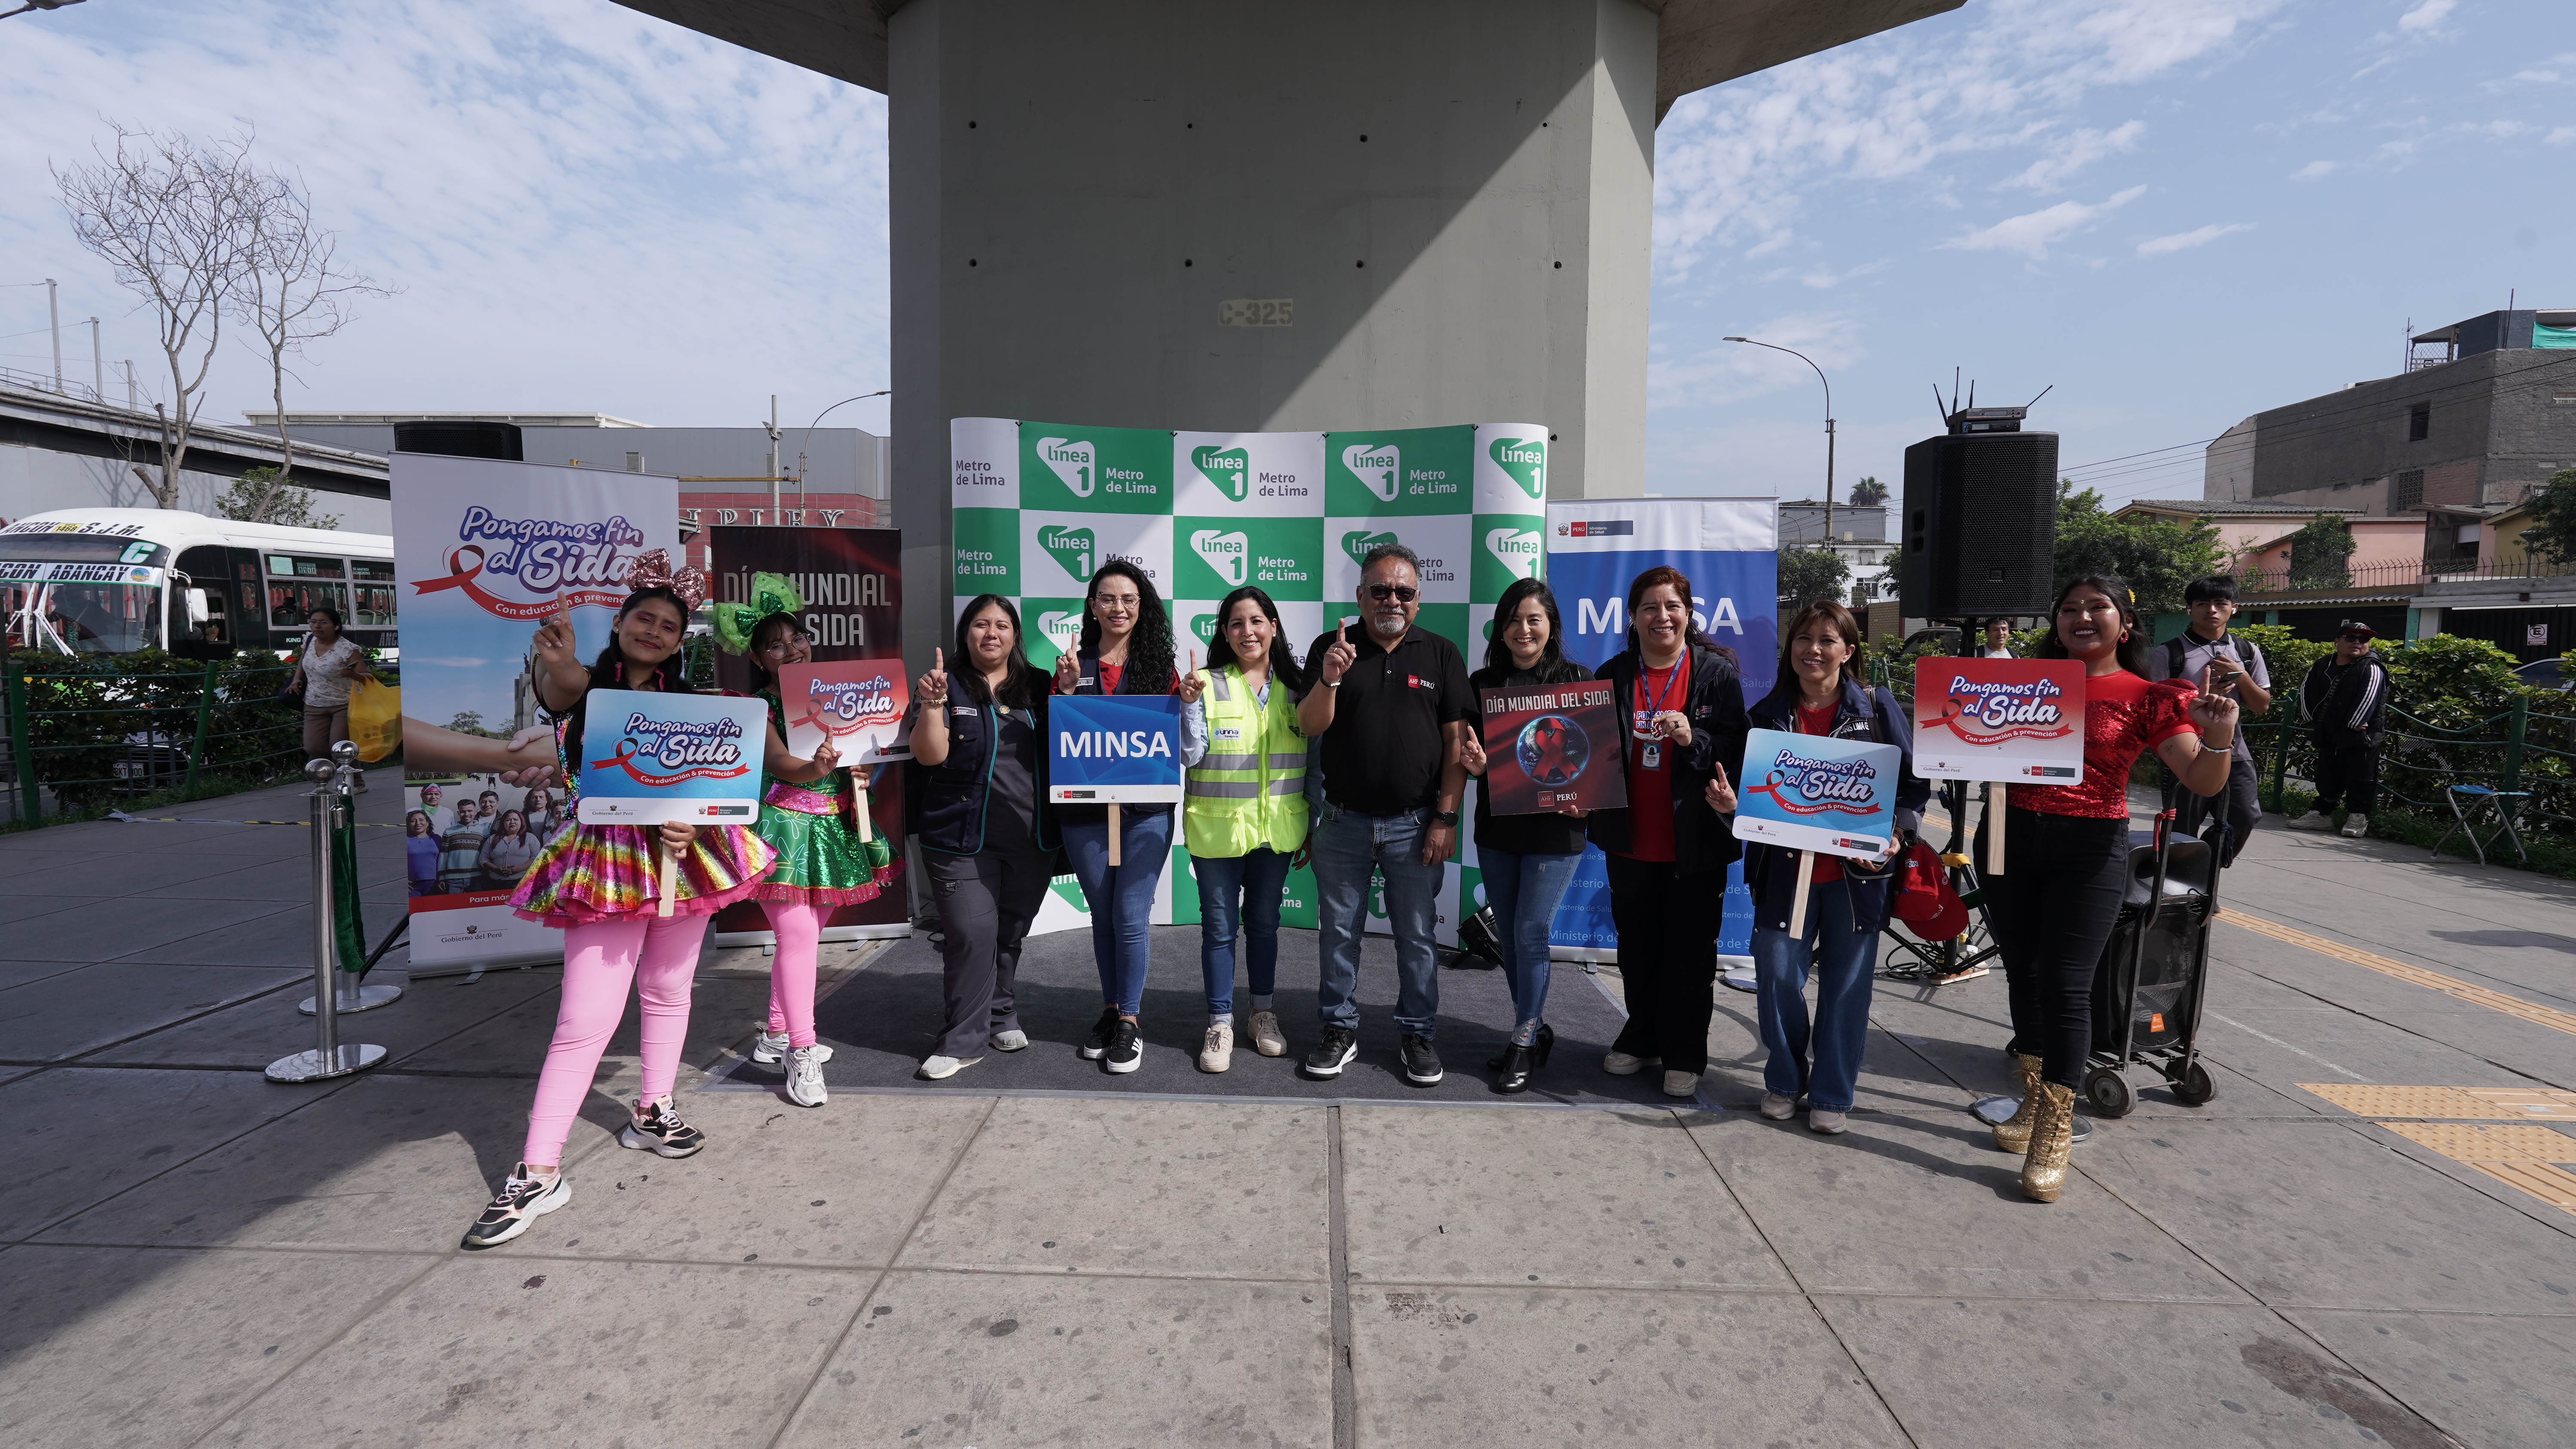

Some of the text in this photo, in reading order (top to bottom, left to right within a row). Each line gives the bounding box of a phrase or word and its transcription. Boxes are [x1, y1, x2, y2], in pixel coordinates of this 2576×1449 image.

[1219, 302, 1293, 325] C-325
[956, 460, 991, 471] Metro
[956, 473, 1005, 486] de Lima
[1077, 467, 1089, 491] 1
[1106, 467, 1144, 480] Metro
[1259, 472, 1295, 483] Metro
[1410, 469, 1446, 481] Metro
[1530, 467, 1541, 493] 1
[1106, 481, 1157, 494] de Lima
[1230, 472, 1243, 496] 1
[1382, 470, 1394, 495] 1
[1410, 482, 1457, 495] de Lima
[1259, 485, 1308, 496] de Lima
[0, 522, 61, 534] ANCON
[462, 507, 641, 544] Pongamos fin
[119, 542, 157, 564] C
[489, 543, 522, 570] al
[957, 549, 993, 561] Metro
[1077, 553, 1090, 577] 1
[1230, 556, 1242, 579] 1
[1258, 556, 1295, 567] Metro
[1419, 558, 1443, 568] etro
[0, 563, 131, 582] CON ABANCAY
[957, 563, 1007, 575] de Lima
[1258, 569, 1307, 581] de Lima
[1426, 570, 1454, 581] Lima
[723, 565, 756, 605] DÍ
[495, 603, 516, 615] Con
[519, 600, 572, 615] educacin
[574, 594, 582, 603] &
[1578, 597, 1744, 635] MSA
[805, 613, 864, 646] SIDA
[810, 675, 890, 695] Pongamos fin
[1420, 679, 1435, 689] PERÚ
[1742, 678, 1772, 688] Salud
[1950, 676, 2060, 698] Pongamos fin
[823, 691, 894, 719] al Sida
[1485, 690, 1610, 713] DÍA MUNDIAL DEL SIDA
[1963, 695, 2060, 726] al Sida
[626, 713, 740, 736] Pongamos fin
[839, 723, 864, 734] educación
[1636, 720, 1646, 729] FIN
[1852, 721, 1865, 731] LIMA
[1965, 734, 1978, 743] Con
[1979, 731, 2013, 743] educación
[640, 734, 740, 767] al Sida
[1060, 731, 1171, 758] MINSA
[1775, 750, 1874, 778] Pongamos fin
[640, 775, 654, 784] Con
[655, 773, 690, 785] educación
[1786, 771, 1872, 800] al Sida
[1556, 791, 1577, 801] PERÚ
[1784, 802, 1795, 811] Con
[1833, 803, 1868, 813] prevención
[1726, 884, 1741, 894] de
[1549, 929, 1604, 942] Ministerio
[1727, 938, 1741, 949] de
